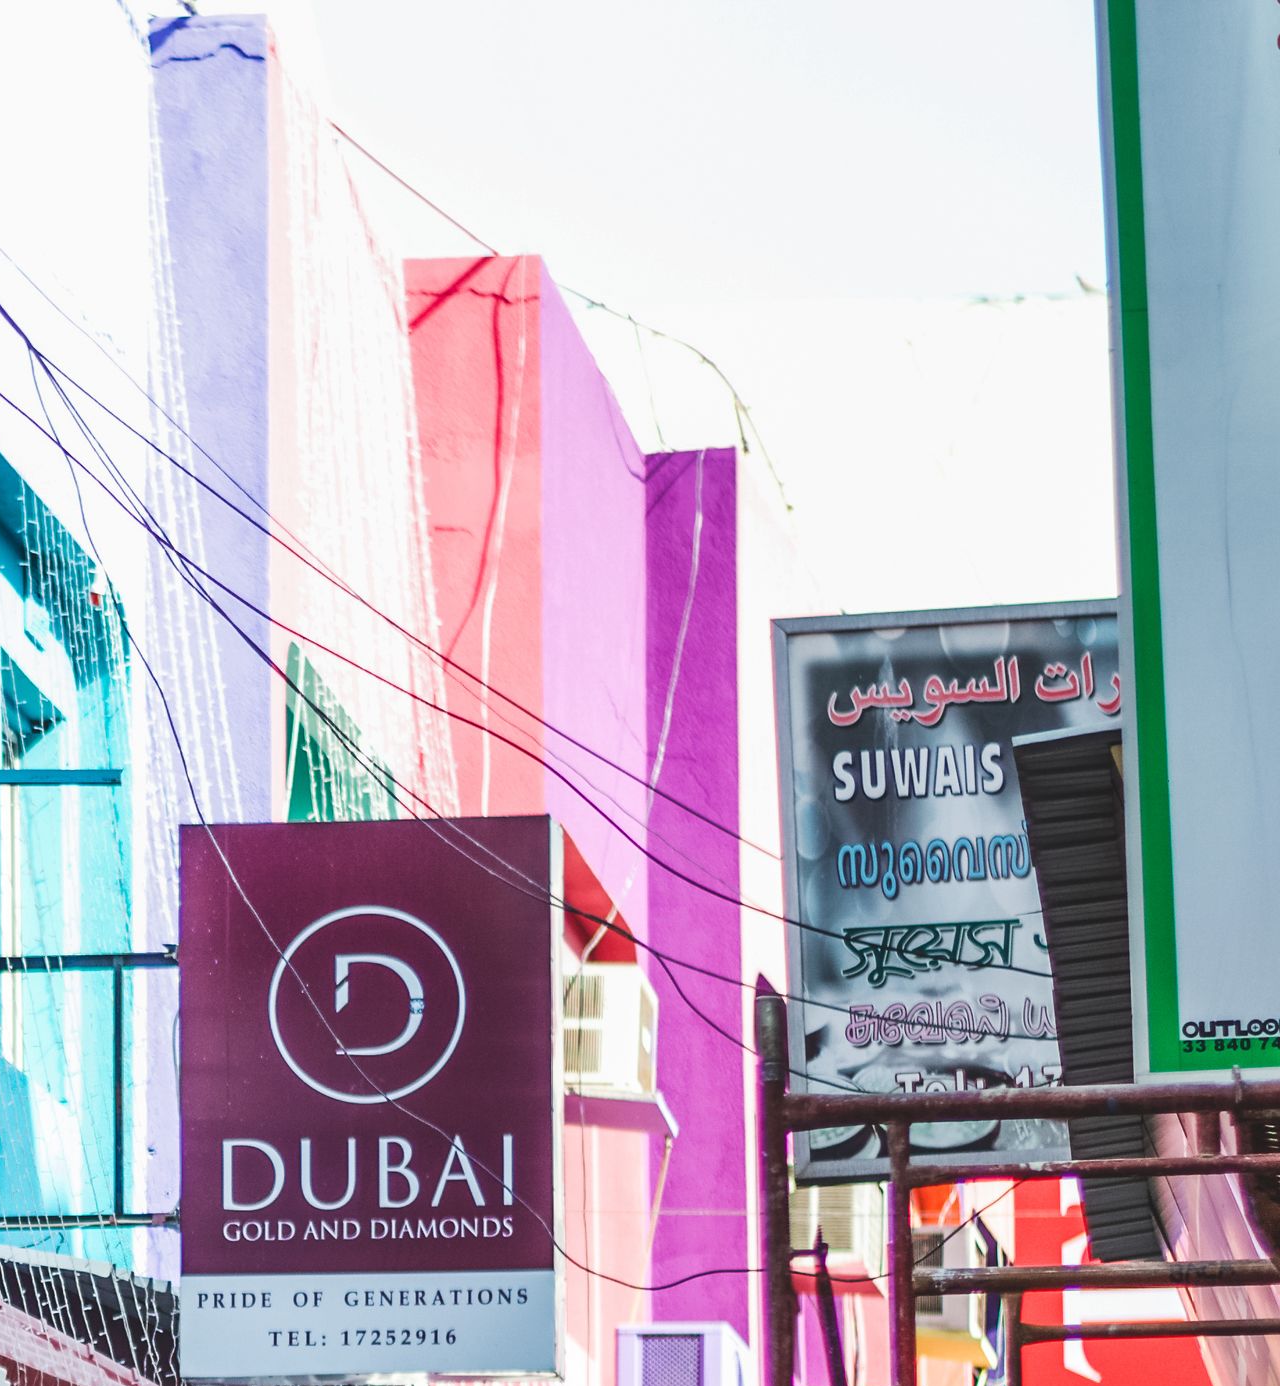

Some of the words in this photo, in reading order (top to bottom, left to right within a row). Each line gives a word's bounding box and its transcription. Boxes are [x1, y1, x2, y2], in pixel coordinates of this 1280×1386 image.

[827, 655, 1022, 727] السويس
[833, 742, 1006, 801] SUWAIS
[1182, 1018, 1280, 1038] OUTLOO
[1183, 1040, 1207, 1053] 33
[1214, 1038, 1251, 1052] 840
[1258, 1036, 1280, 1051] 74
[221, 1133, 514, 1212] DUBAI
[222, 1219, 297, 1243] GOLD
[302, 1219, 362, 1241] AND
[369, 1216, 514, 1240] DIAMONDS
[197, 1290, 273, 1310] PRIDE
[292, 1289, 324, 1308] OF
[343, 1286, 530, 1307] GENERATIONS
[268, 1330, 328, 1348] TEL:
[340, 1328, 458, 1347] 17252916
